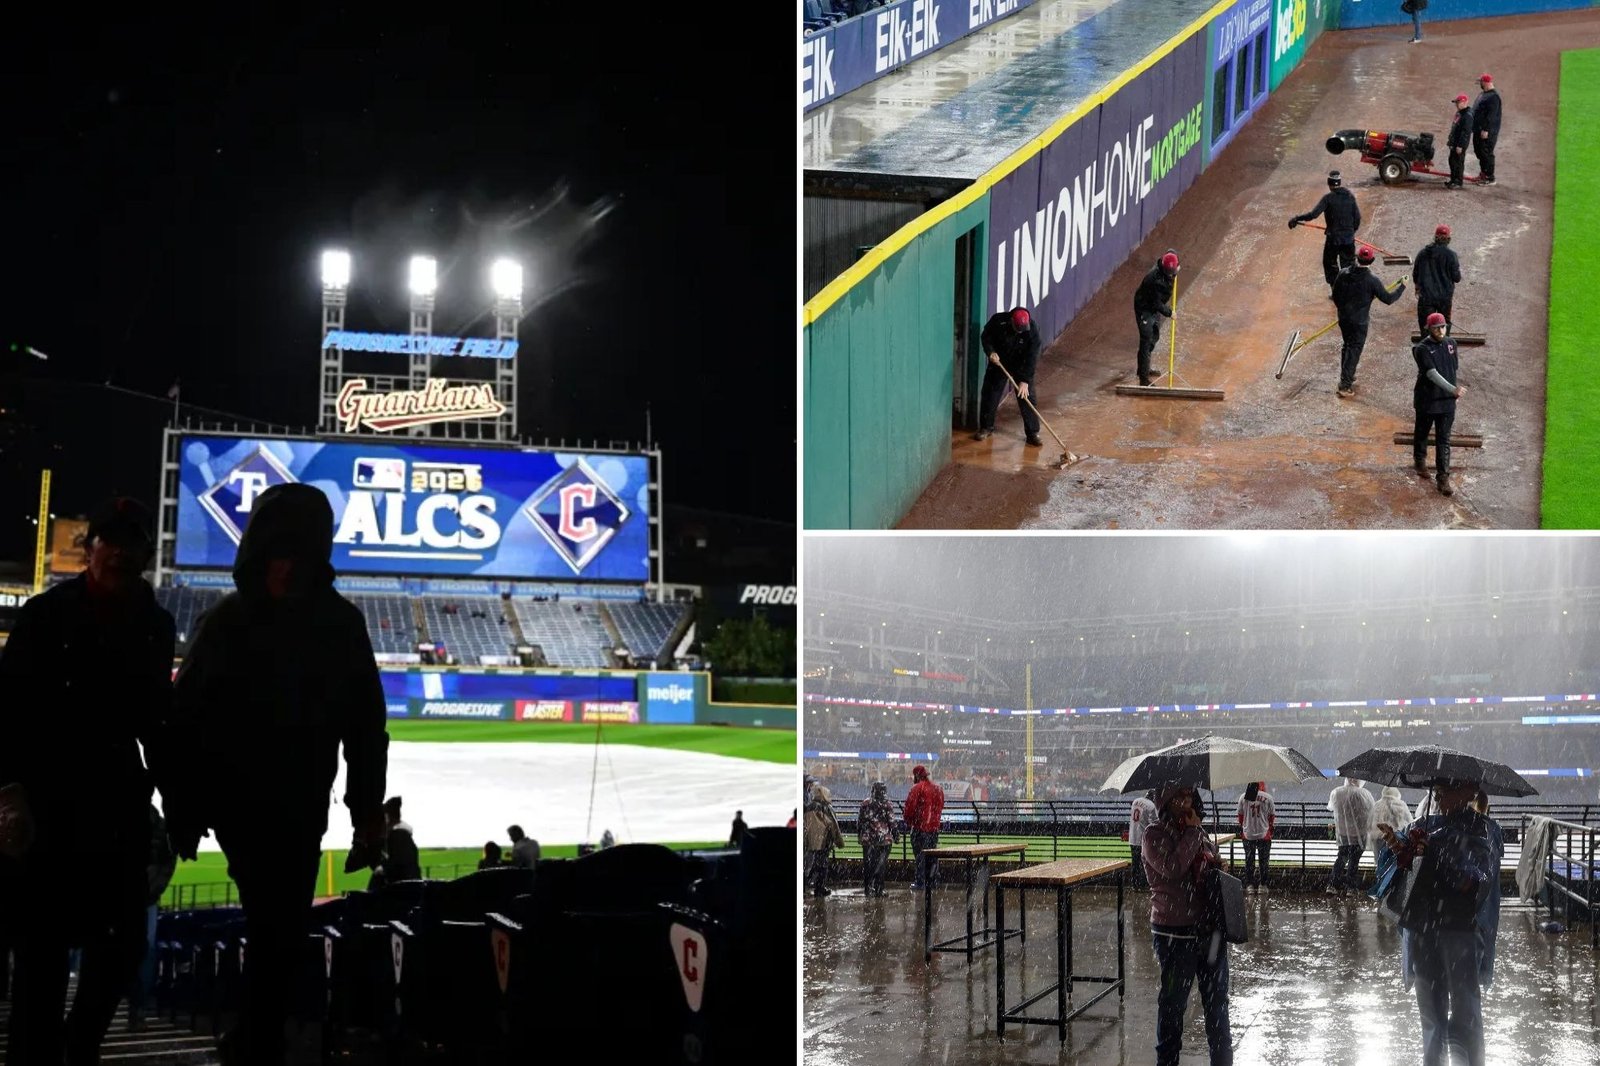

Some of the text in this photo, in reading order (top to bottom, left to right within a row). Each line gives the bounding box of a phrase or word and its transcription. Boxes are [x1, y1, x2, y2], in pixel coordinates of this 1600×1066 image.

[875, 0, 940, 73] Elk+Elk
[1151, 101, 1203, 189] MORTGAGE
[322, 331, 461, 356] PROGRESSIVE
[336, 378, 499, 432] Guardians
[333, 491, 501, 549] ALCS
[558, 484, 597, 543] C
[740, 584, 797, 605] PROG
[422, 702, 504, 717] PROGRESSIVE
[648, 684, 693, 704] meijer
[683, 937, 699, 983] C
